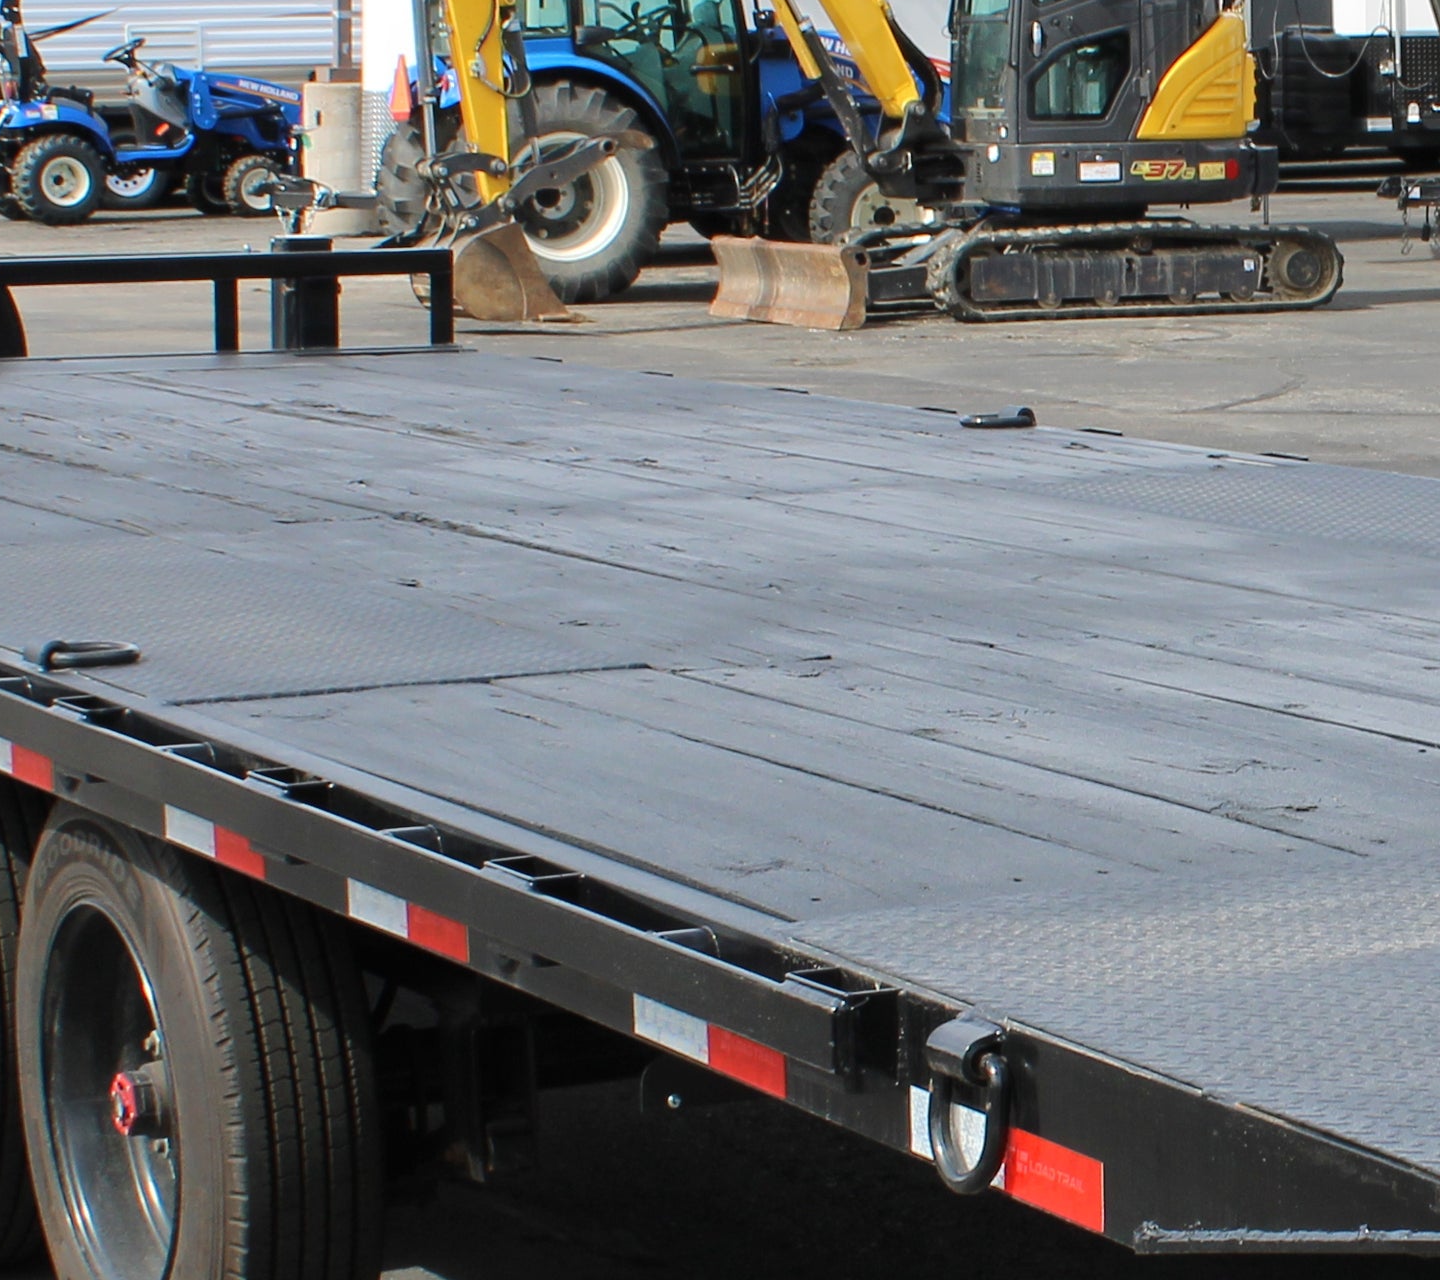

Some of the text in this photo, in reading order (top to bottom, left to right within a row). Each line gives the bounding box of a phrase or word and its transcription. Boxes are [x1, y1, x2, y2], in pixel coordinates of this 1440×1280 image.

[239, 79, 299, 101] NEW HOLLAND
[1029, 1160, 1086, 1193] LOAD TRAIL
